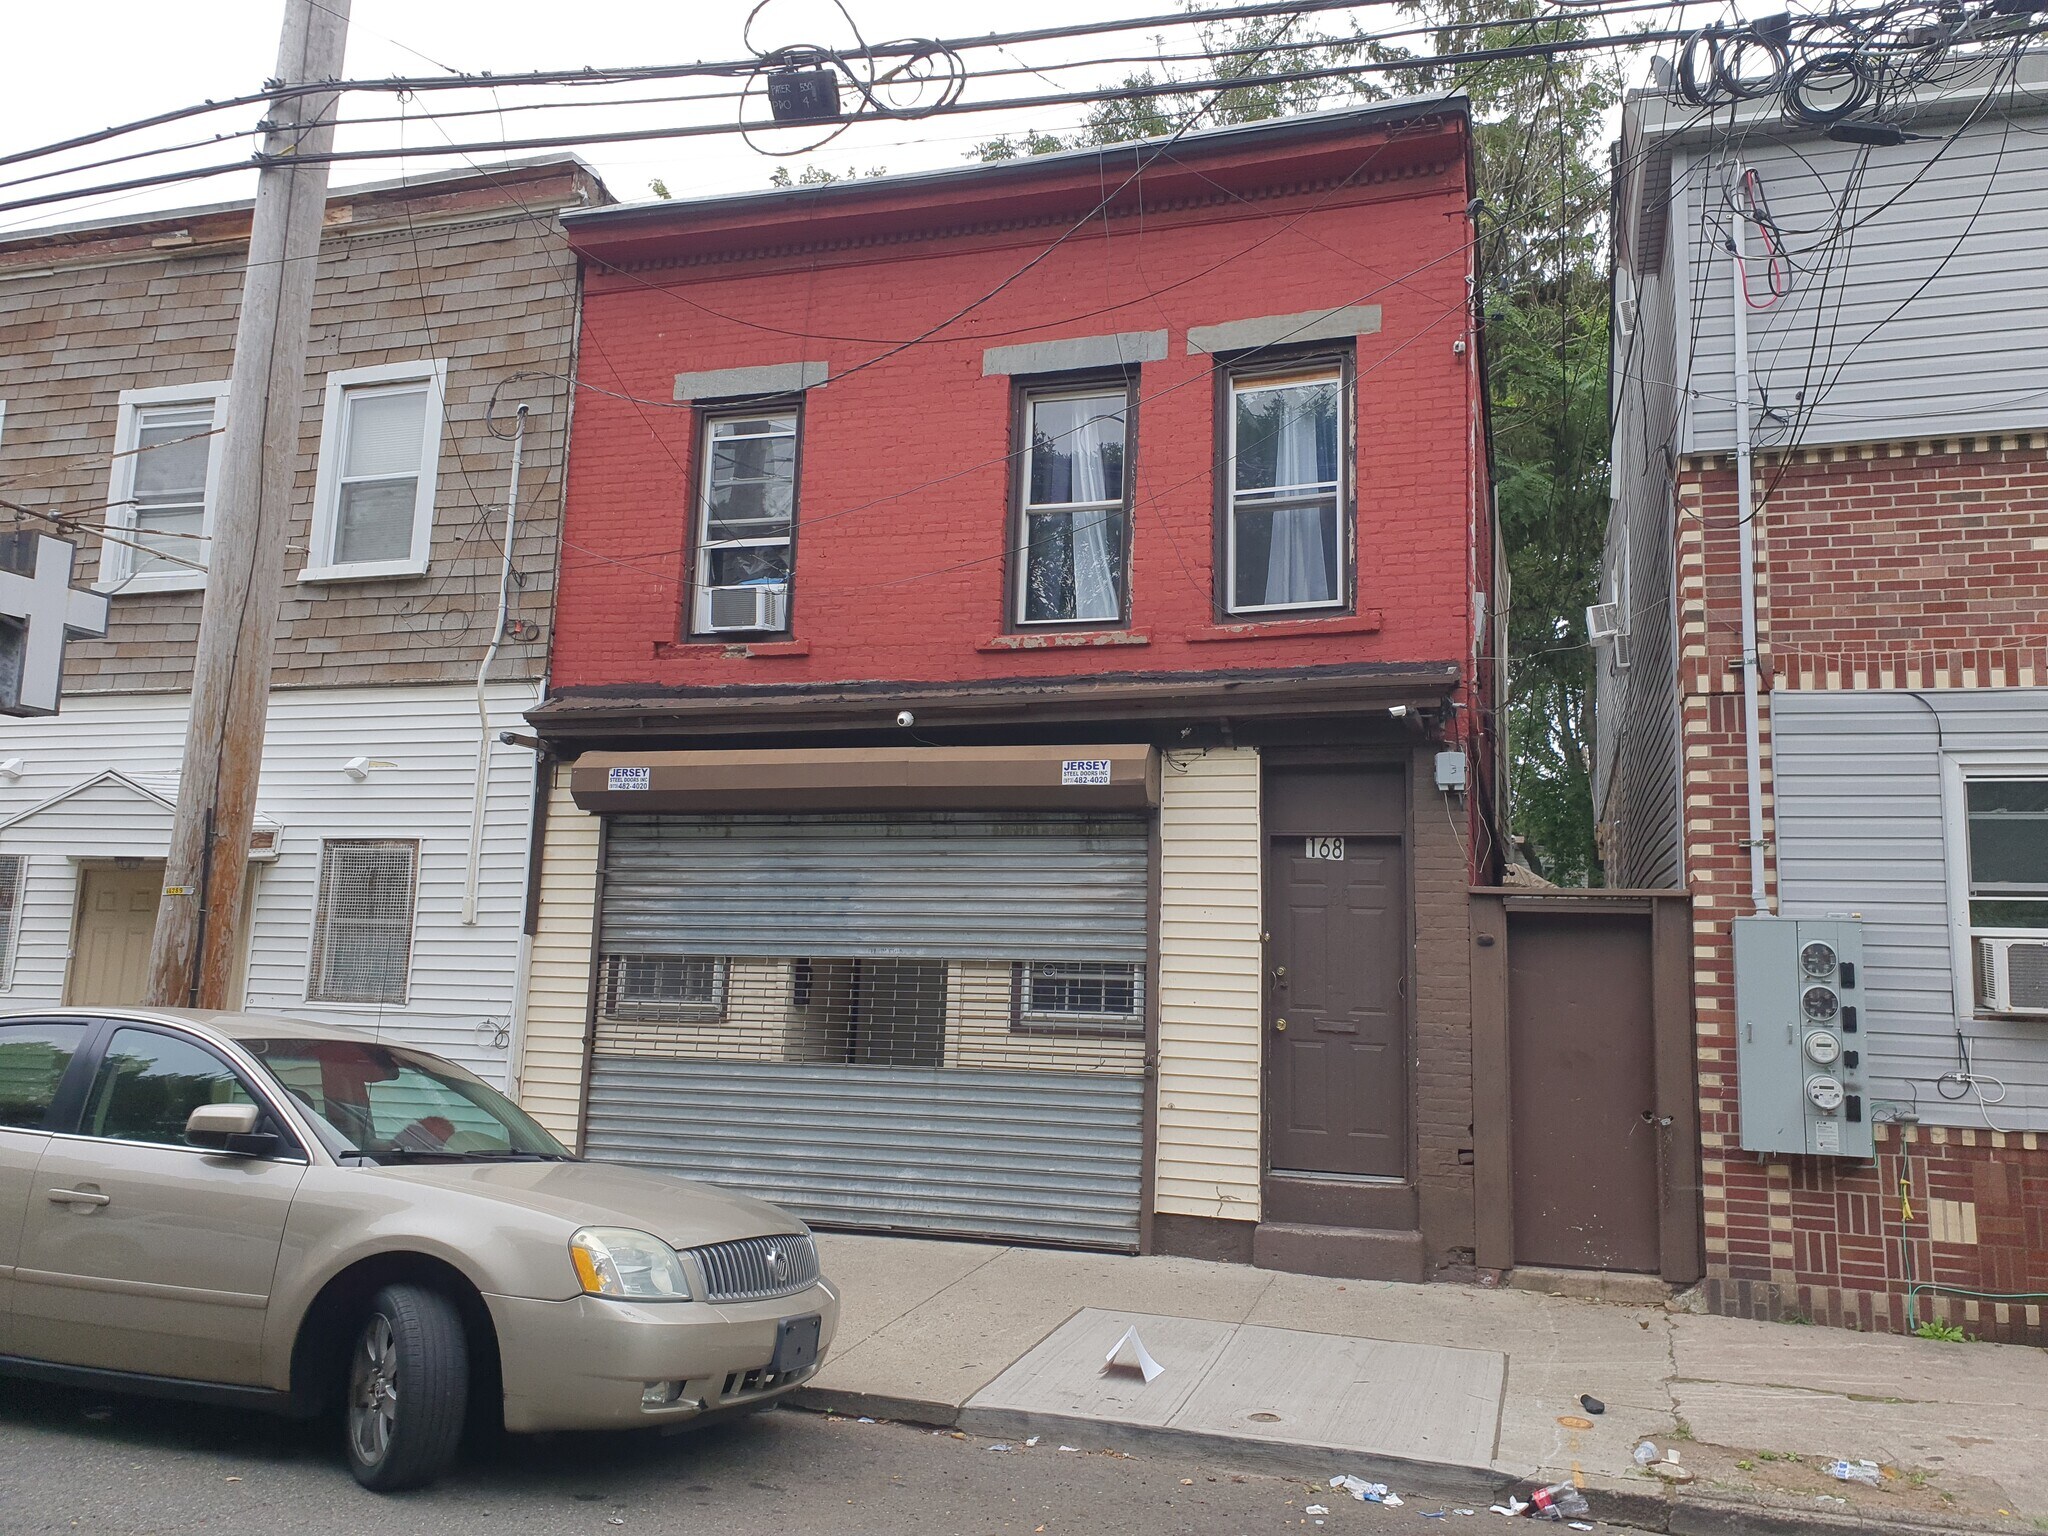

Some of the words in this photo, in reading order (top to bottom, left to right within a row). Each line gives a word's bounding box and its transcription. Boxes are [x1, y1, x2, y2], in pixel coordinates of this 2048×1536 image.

[1063, 761, 1108, 770] JERSEY
[610, 769, 648, 777] JERSEY
[1309, 836, 1342, 860] 168
